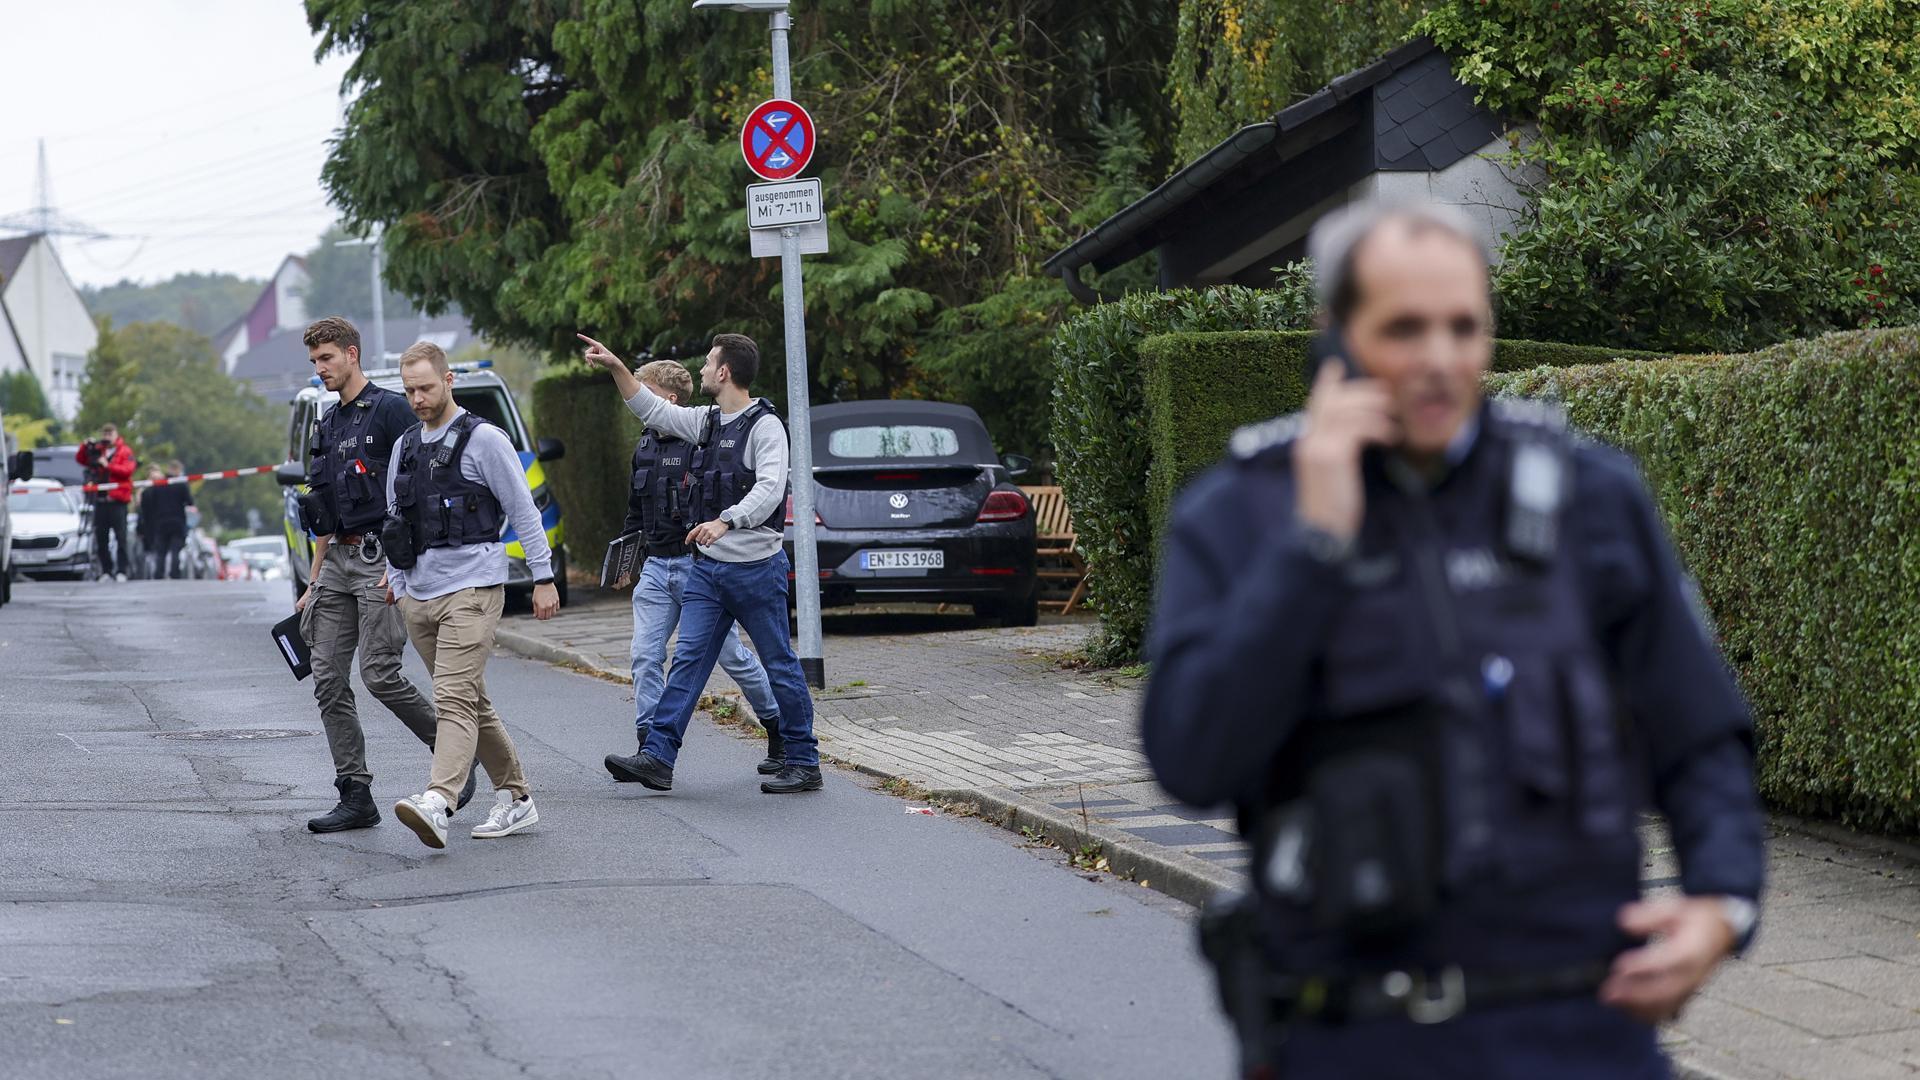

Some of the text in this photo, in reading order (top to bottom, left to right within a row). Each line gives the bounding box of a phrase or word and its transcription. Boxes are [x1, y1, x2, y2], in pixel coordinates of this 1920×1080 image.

[755, 189, 813, 203] ausgenommen
[758, 205, 772, 217] Mi
[806, 201, 812, 212] h
[663, 458, 681, 466] POLIZEI
[869, 553, 942, 566] EN IS 1968
